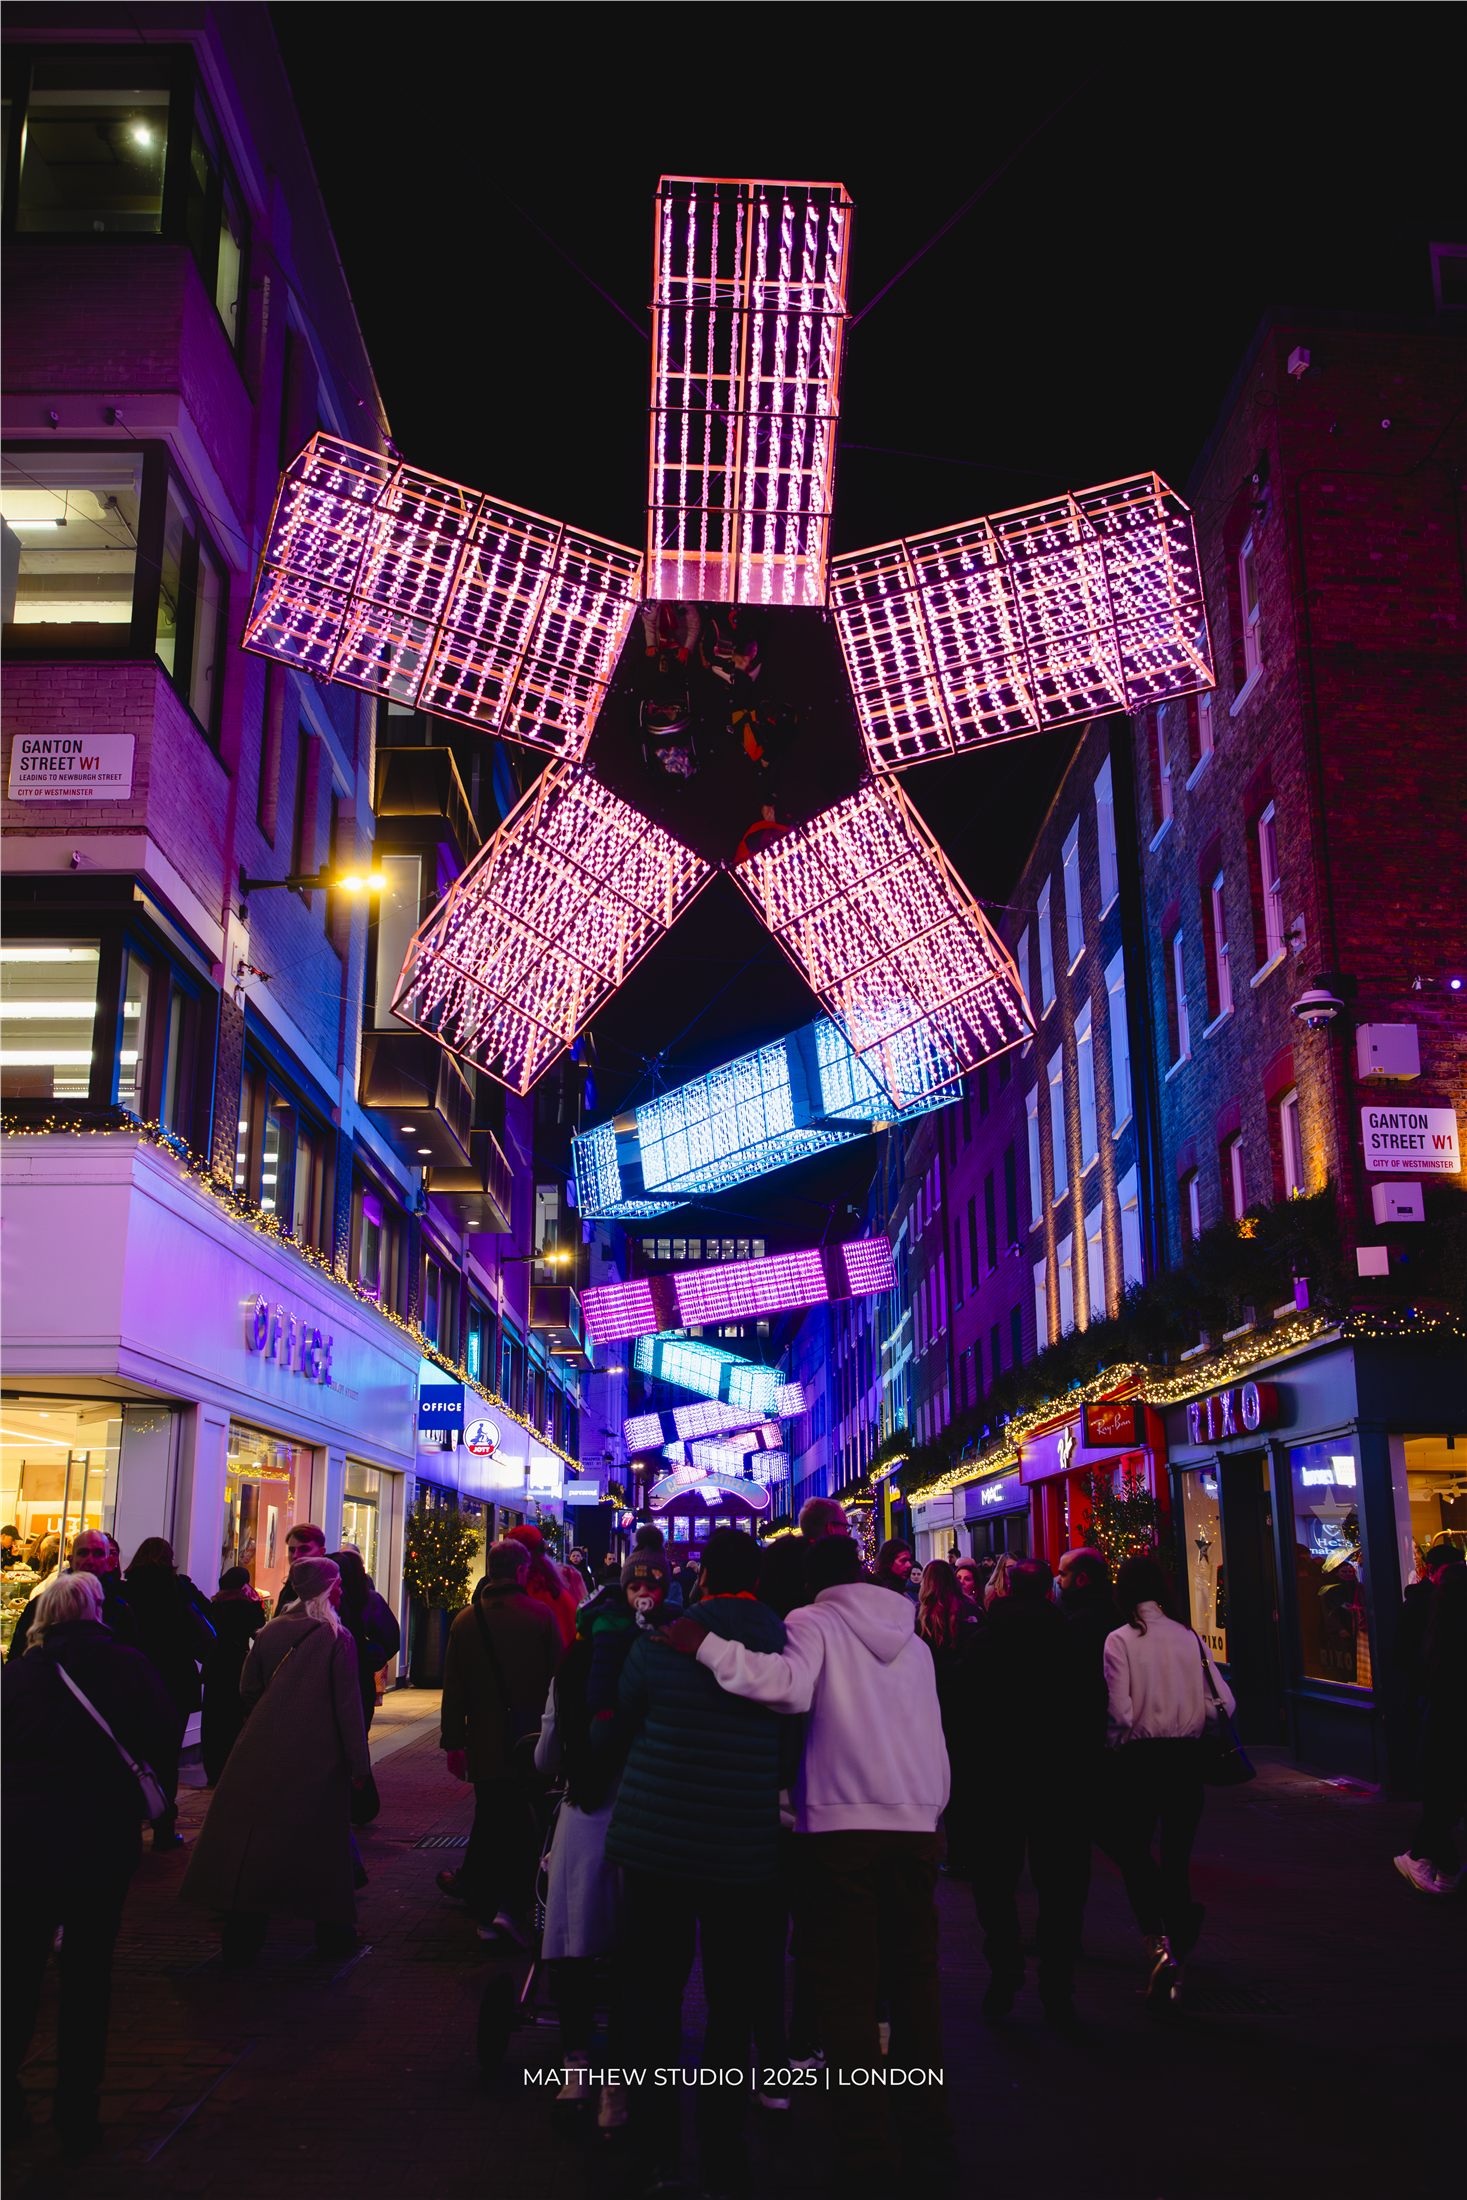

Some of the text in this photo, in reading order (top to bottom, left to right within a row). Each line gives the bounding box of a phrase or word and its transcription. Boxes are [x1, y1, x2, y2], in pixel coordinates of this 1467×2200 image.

[22, 740, 83, 753] GANTON
[20, 756, 100, 770] STREET W1
[1369, 1113, 1428, 1129] GANTON
[1371, 1133, 1453, 1150] STREET W1
[1372, 1159, 1389, 1167] CITY
[1402, 1160, 1454, 1169] WESTMINSTER
[246, 1293, 334, 1386] OFFICE
[422, 1402, 462, 1412] OFFICE
